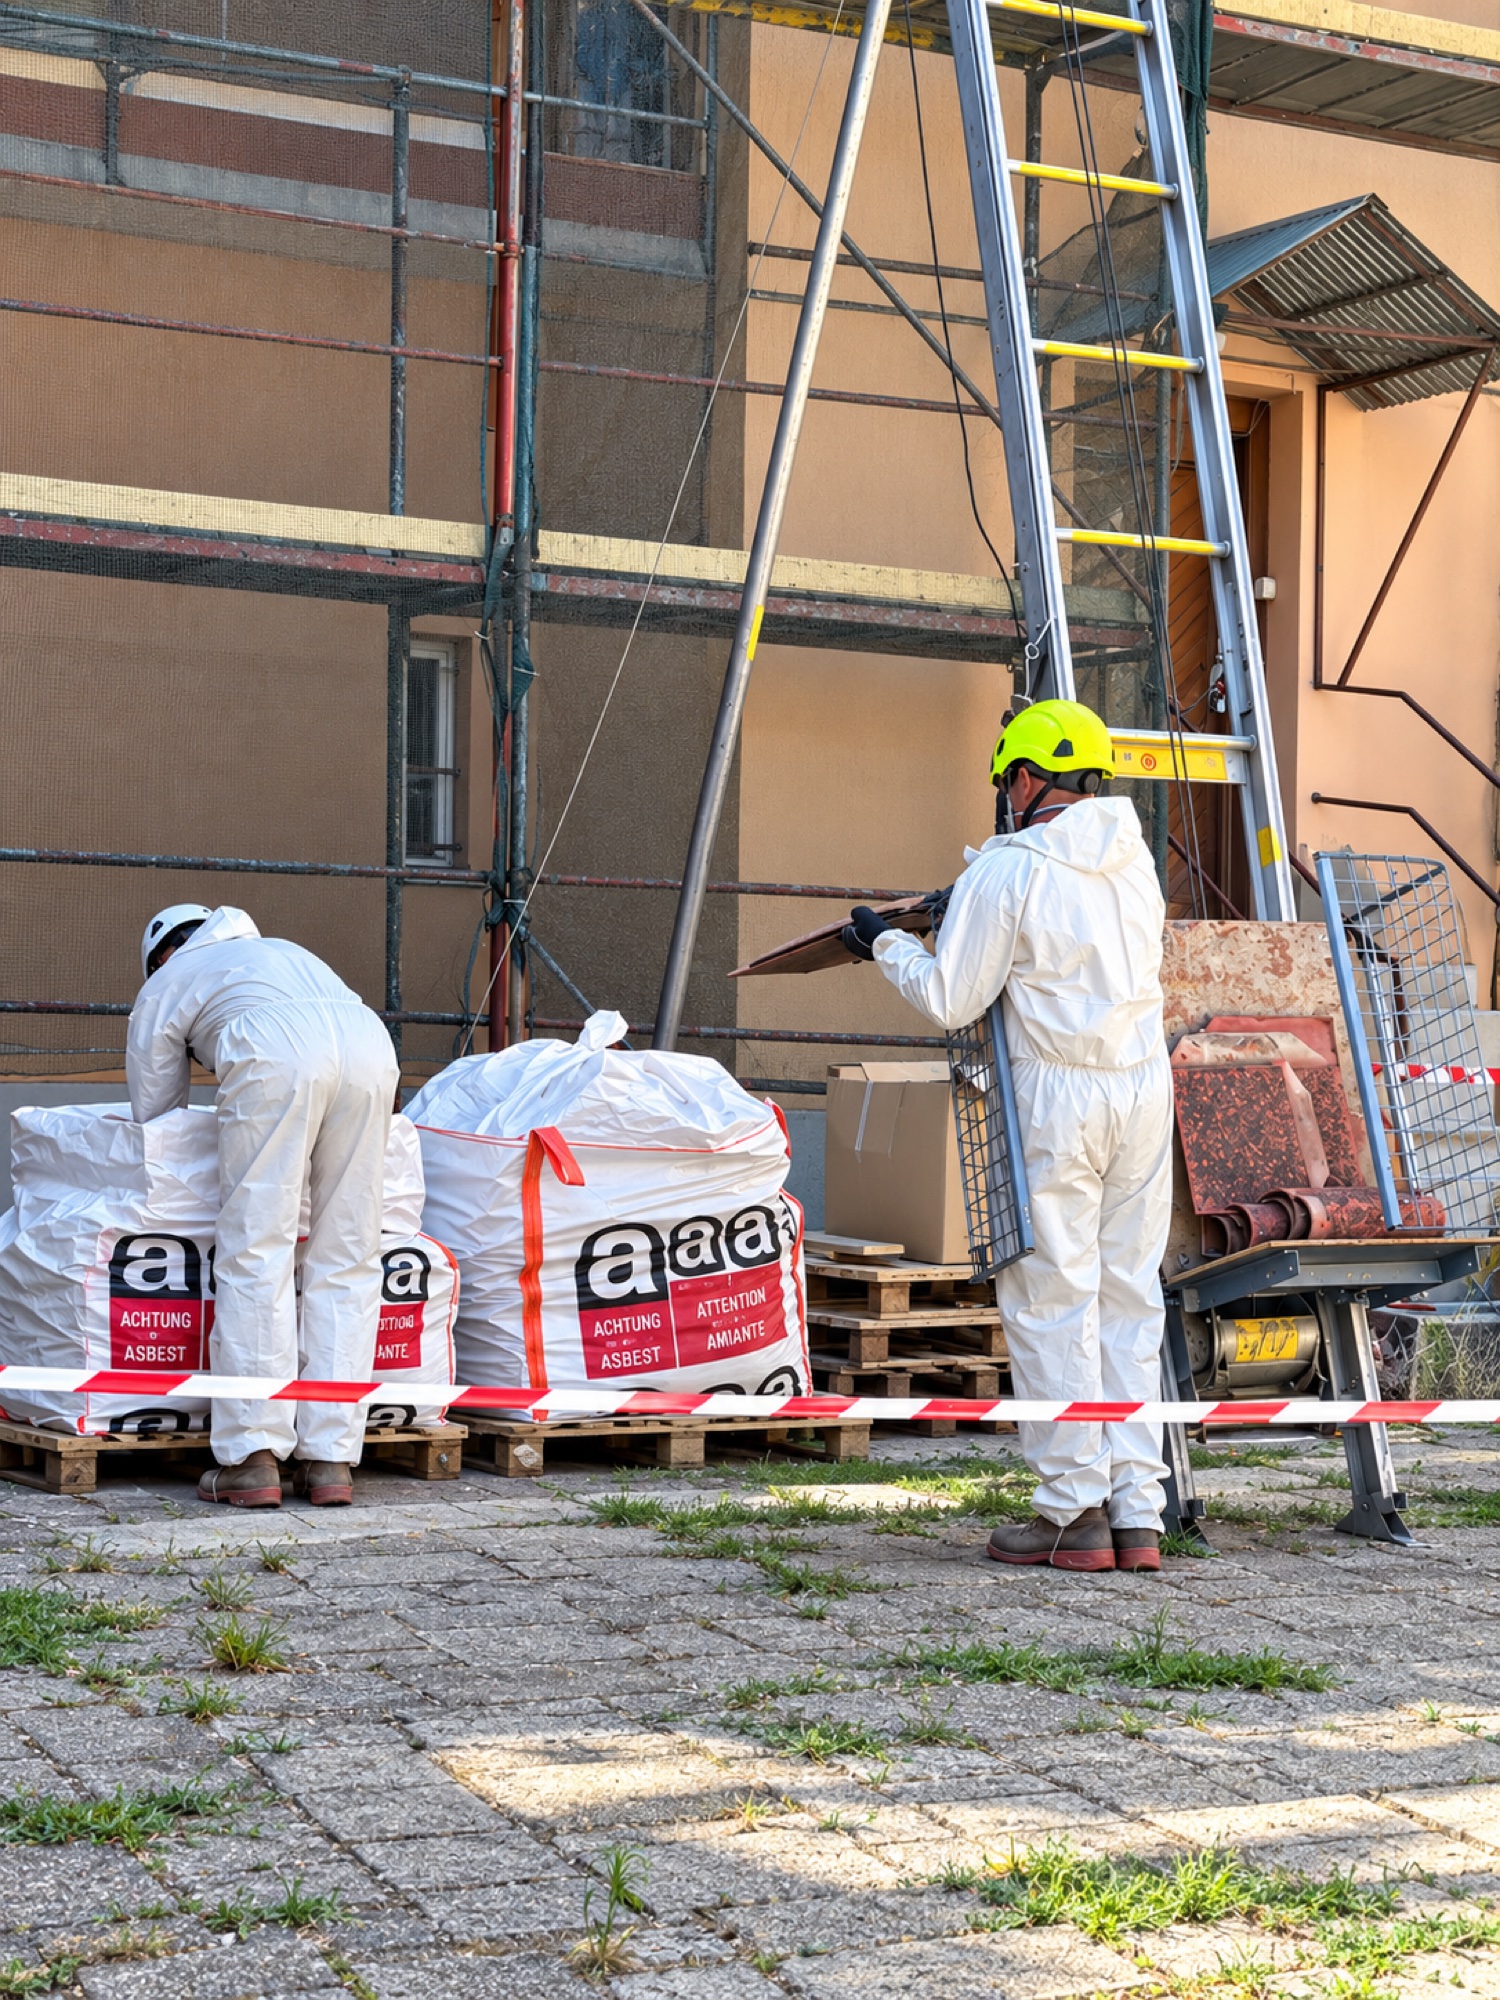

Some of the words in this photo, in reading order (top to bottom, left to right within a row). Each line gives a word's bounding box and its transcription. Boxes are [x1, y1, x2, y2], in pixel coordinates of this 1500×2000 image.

[697, 1286, 766, 1319] ATTENTION
[120, 1311, 192, 1328] ACHTUNG
[593, 1312, 662, 1337] ACHTUNG
[707, 1320, 765, 1351] AMIANTE
[124, 1345, 187, 1362] ASBEST
[376, 1342, 410, 1360] ANTE
[601, 1346, 661, 1370] ASBEST
